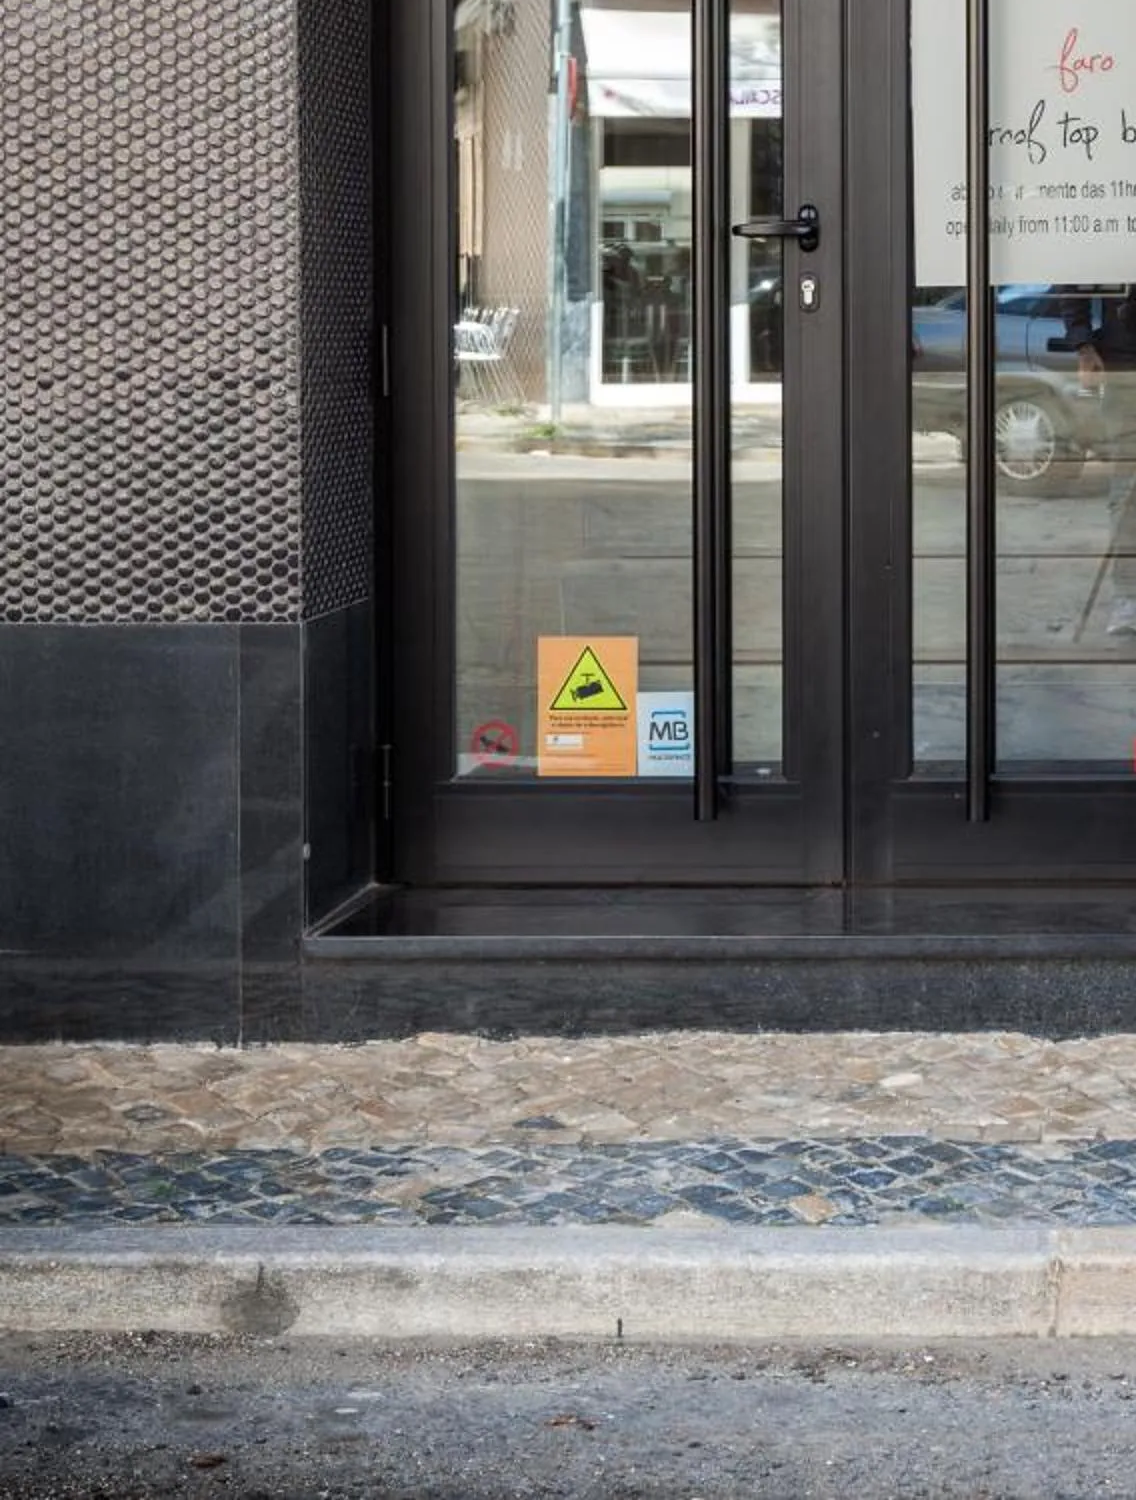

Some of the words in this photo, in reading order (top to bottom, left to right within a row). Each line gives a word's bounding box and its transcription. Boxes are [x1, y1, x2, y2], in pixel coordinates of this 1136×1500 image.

[1044, 28, 1116, 93] faro
[1056, 111, 1100, 161] top
[1081, 181, 1105, 199] das
[1019, 216, 1049, 233] from
[1055, 215, 1089, 233] 11:00
[649, 721, 689, 741] MB
